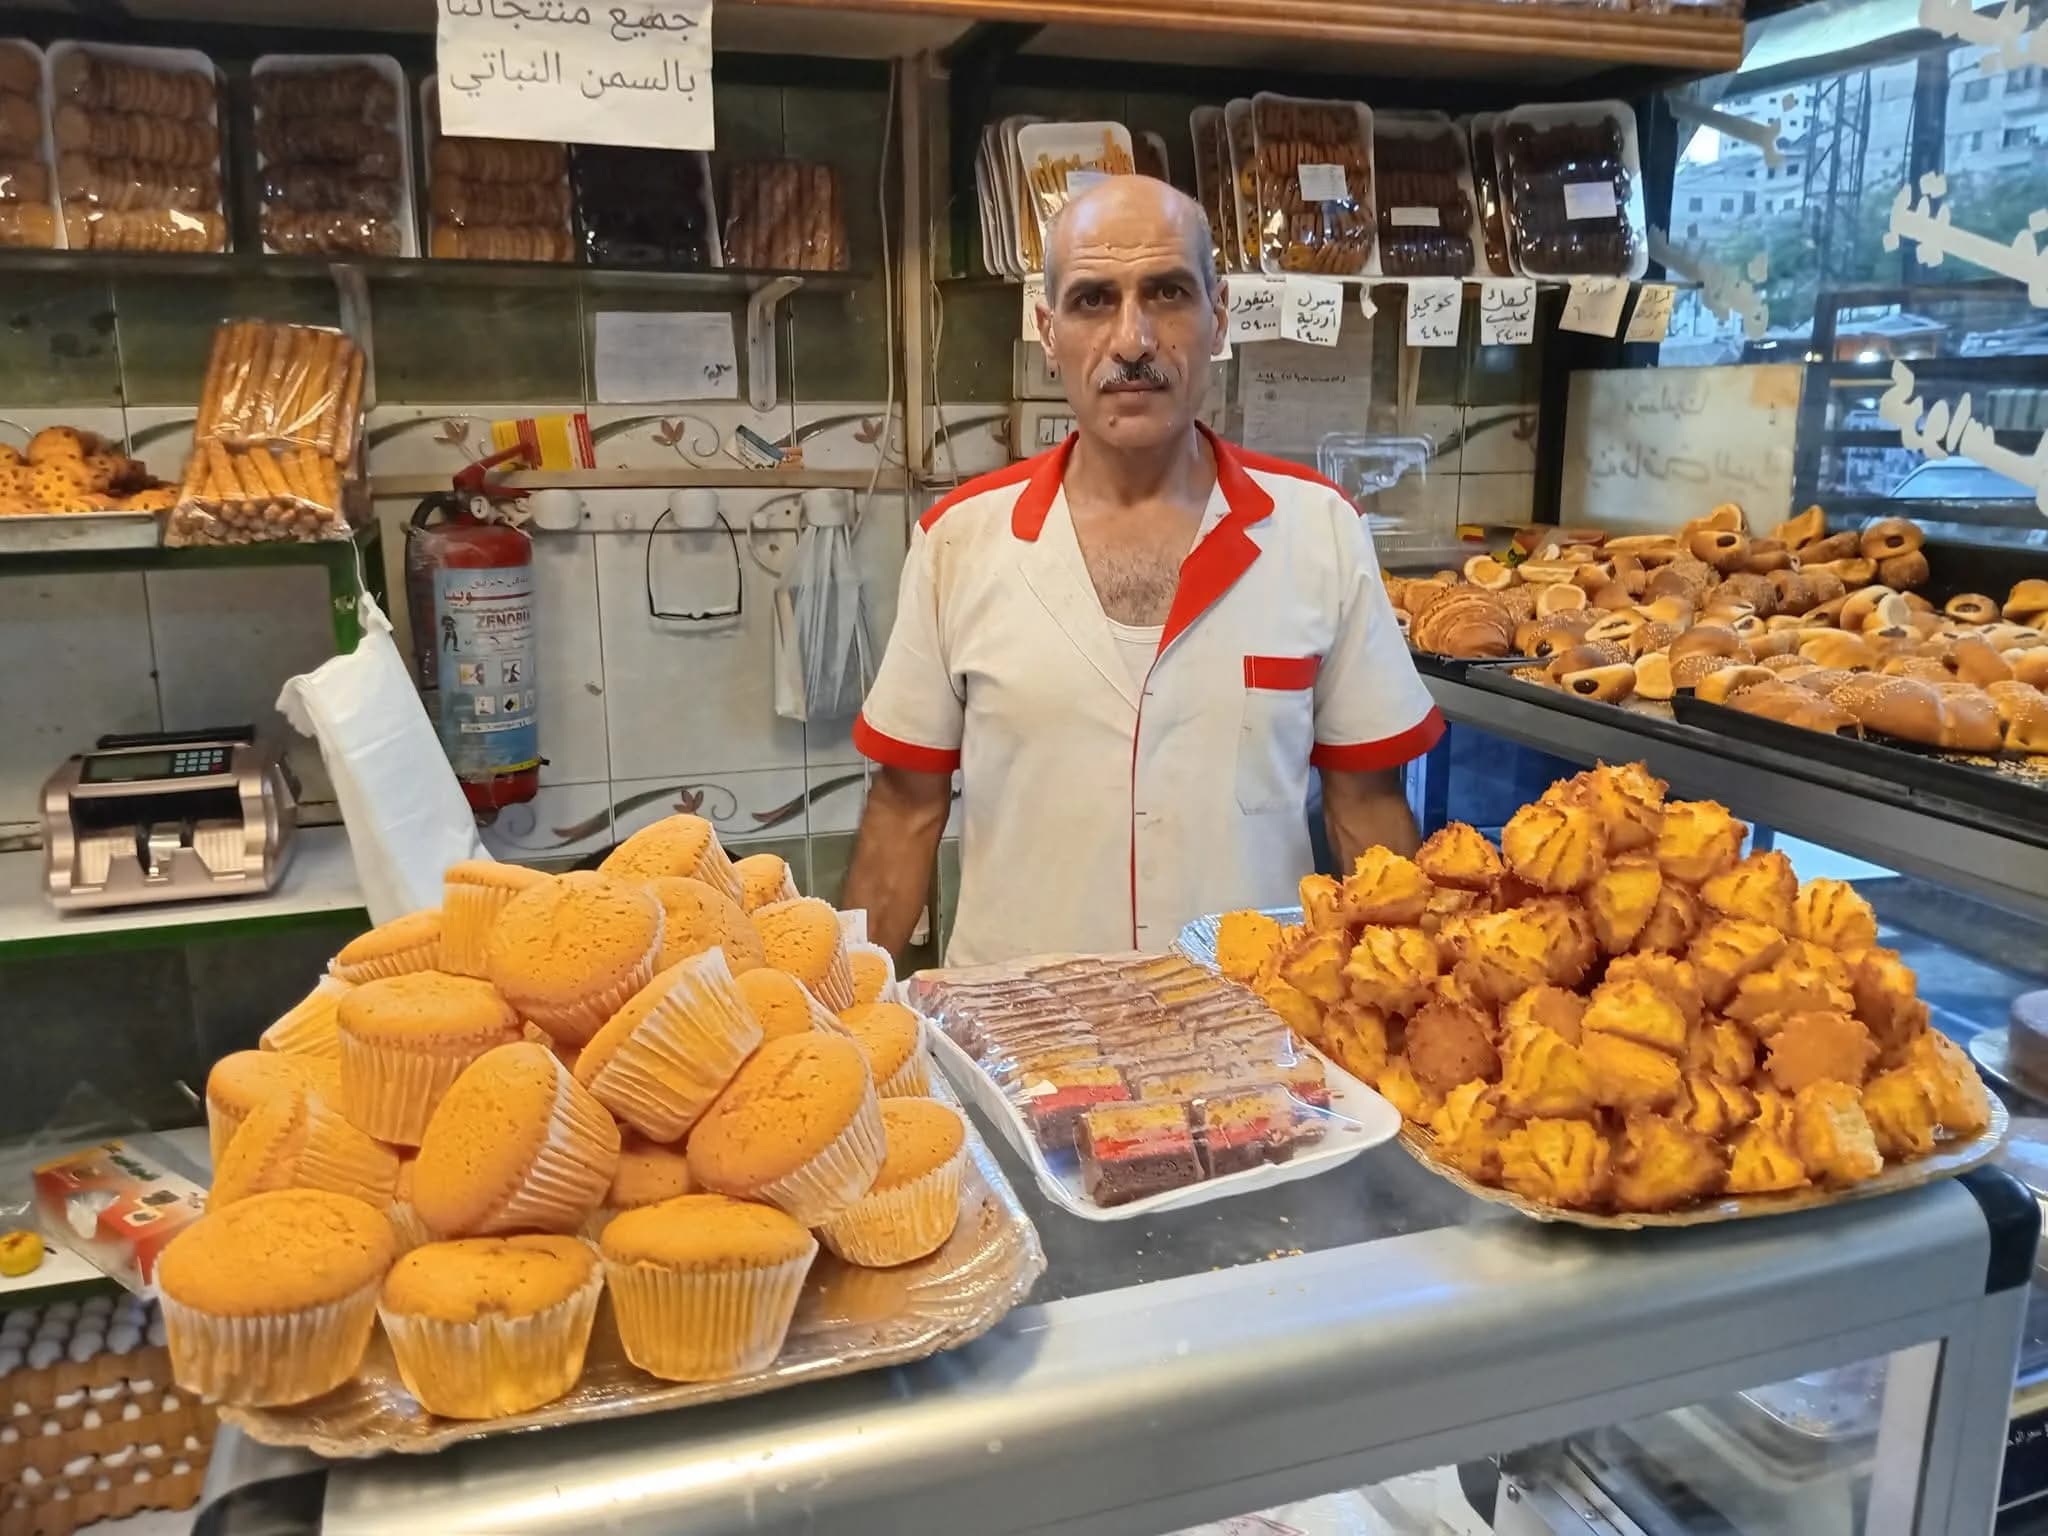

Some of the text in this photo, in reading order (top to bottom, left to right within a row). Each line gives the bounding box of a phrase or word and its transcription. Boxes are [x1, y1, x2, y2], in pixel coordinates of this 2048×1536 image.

[608, 7, 698, 41] جميع
[449, 48, 696, 101] بالسمن النباتي
[1230, 290, 1275, 314] بتيفور
